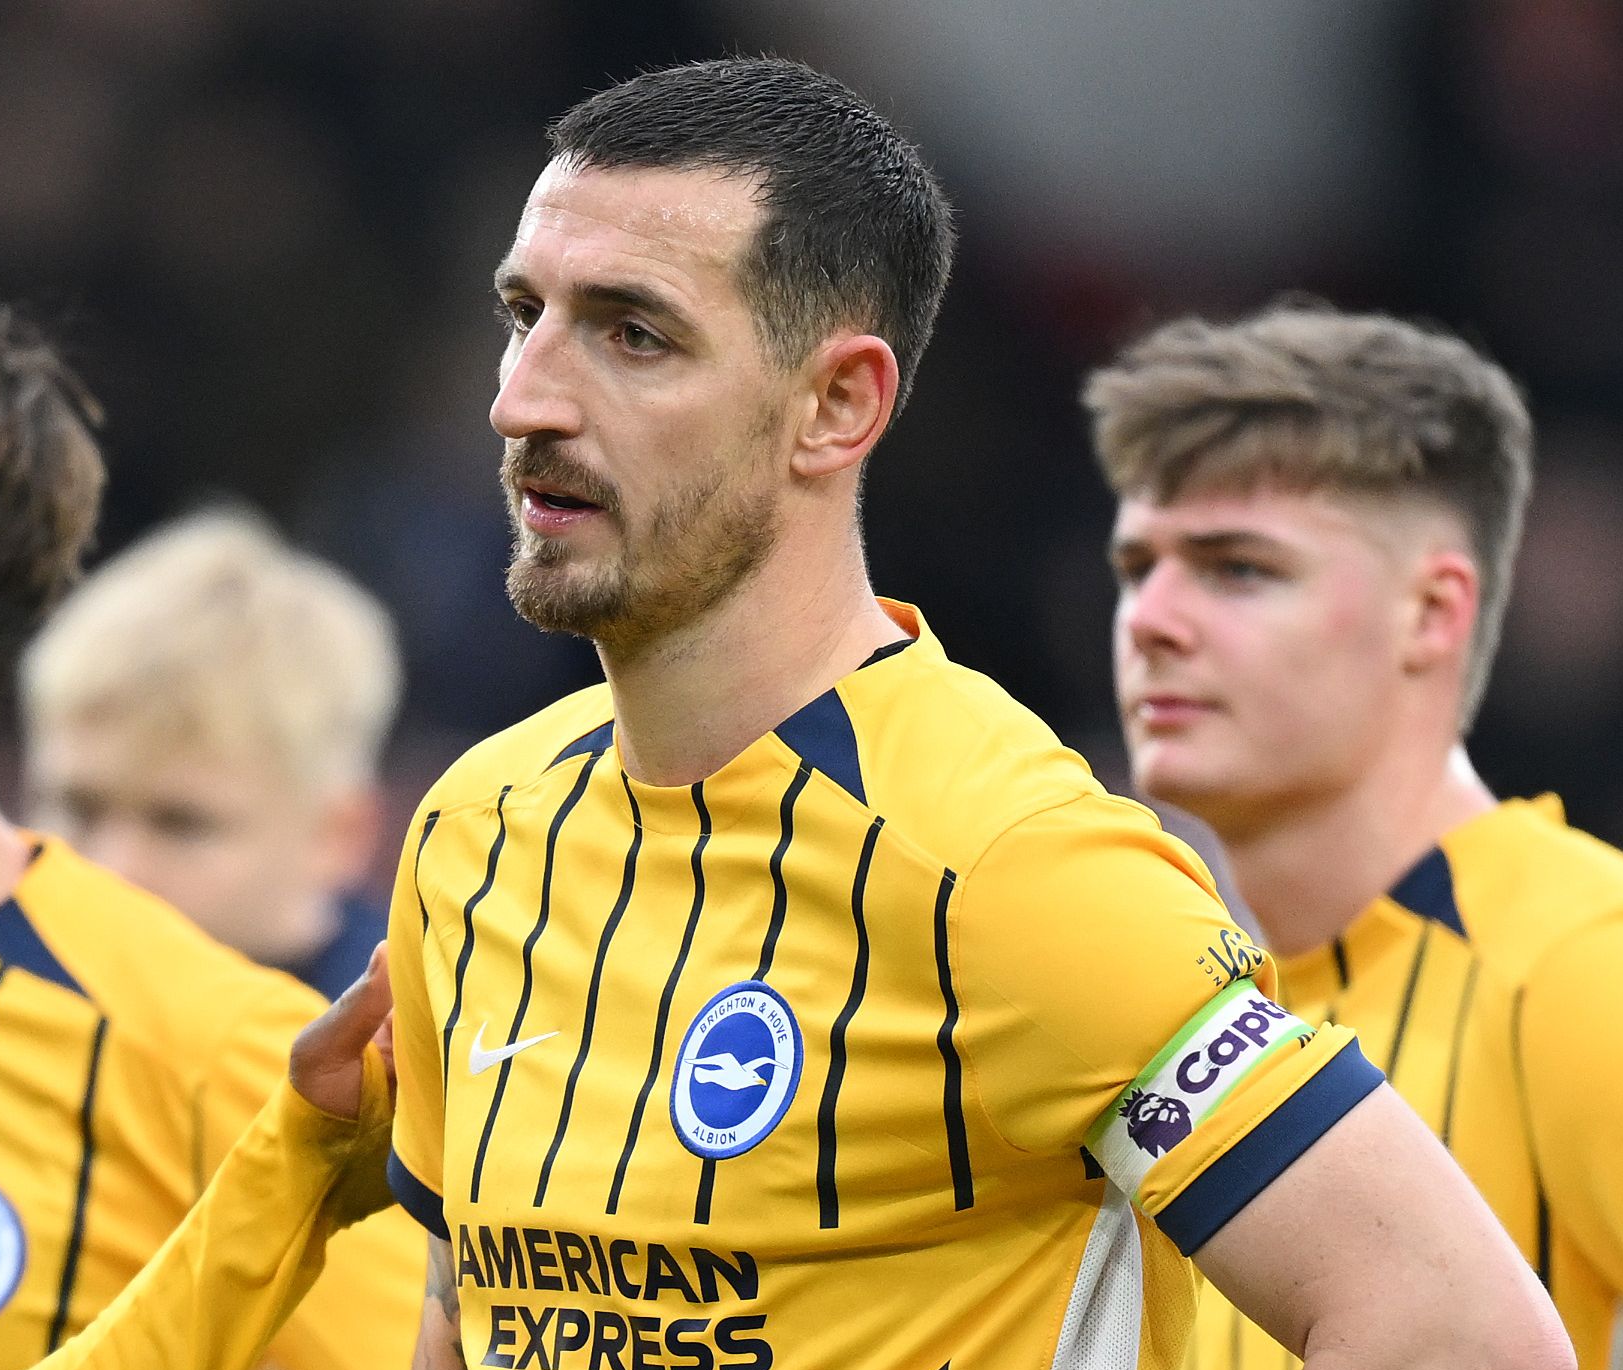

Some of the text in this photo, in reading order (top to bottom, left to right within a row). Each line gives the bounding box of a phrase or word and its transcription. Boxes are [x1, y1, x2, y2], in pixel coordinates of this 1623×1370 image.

[700, 997, 788, 1044] BRIGHTON & HOVE
[1176, 999, 1293, 1094] Capt
[692, 1126, 737, 1145] ALBION
[457, 1223, 760, 1305] AMERICAN
